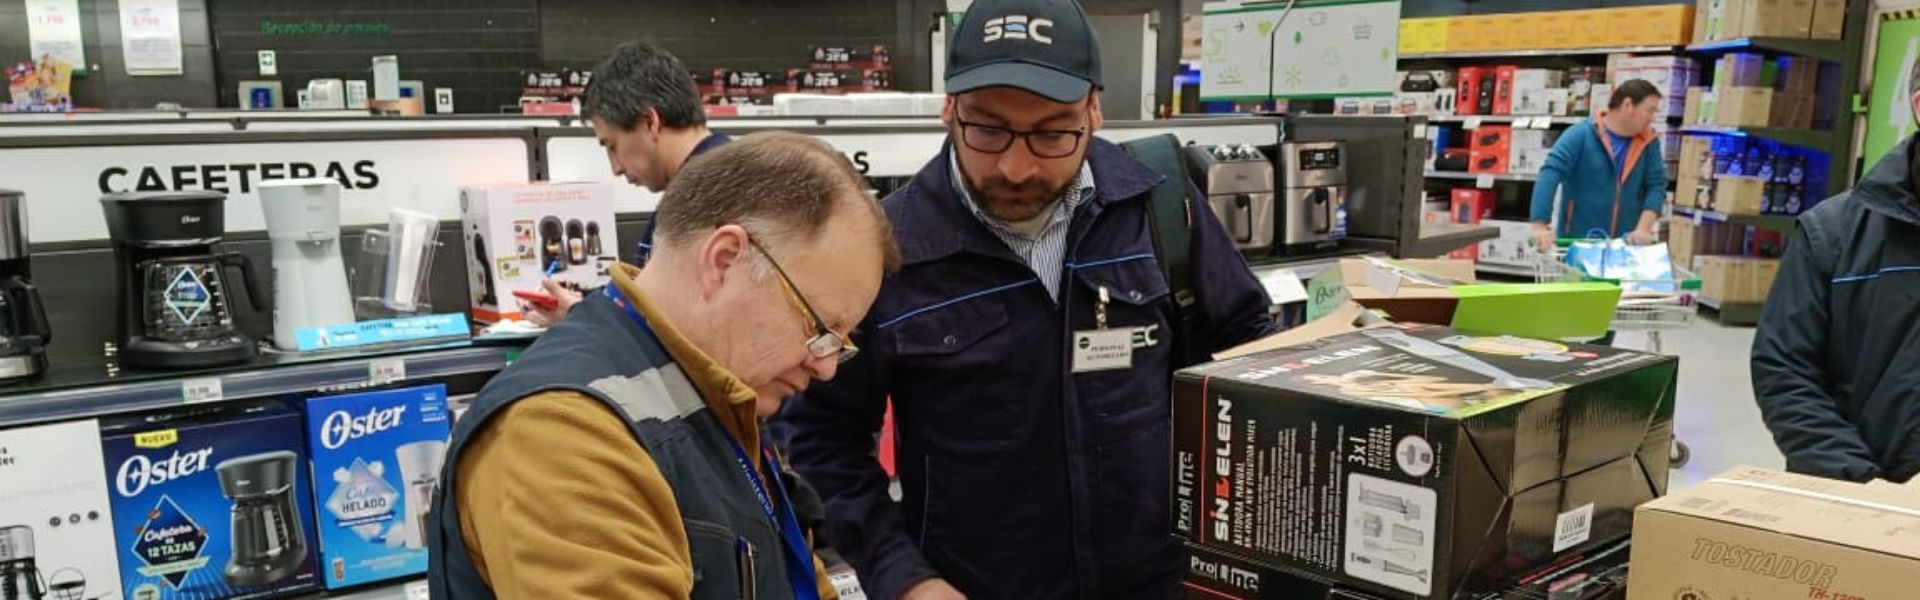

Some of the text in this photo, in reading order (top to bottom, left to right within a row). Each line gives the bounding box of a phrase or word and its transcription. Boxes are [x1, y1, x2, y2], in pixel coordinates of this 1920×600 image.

[984, 15, 1053, 44] SEC
[98, 160, 379, 194] CAFETERAS
[321, 404, 406, 450] Oster
[116, 446, 213, 497] Oster
[342, 498, 387, 513] HELADO
[162, 541, 196, 555] TAZAS
[1691, 538, 1838, 588] TOSTADOR
